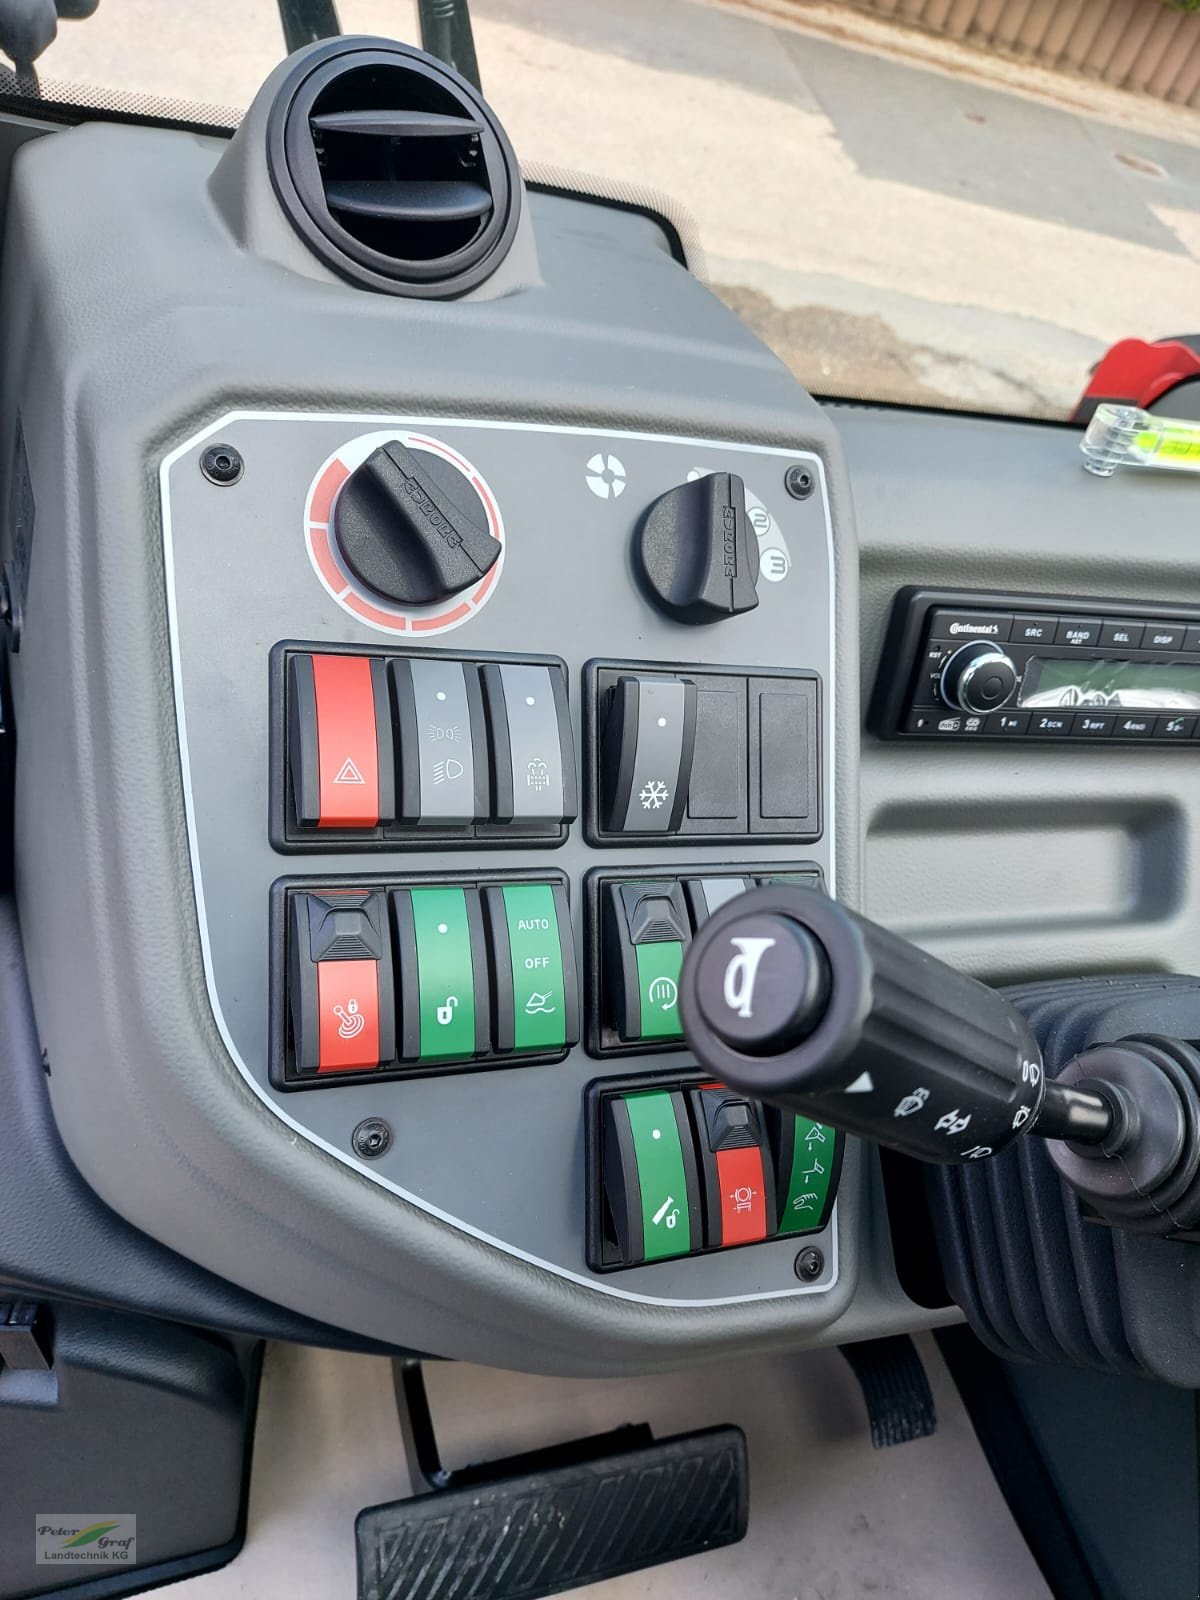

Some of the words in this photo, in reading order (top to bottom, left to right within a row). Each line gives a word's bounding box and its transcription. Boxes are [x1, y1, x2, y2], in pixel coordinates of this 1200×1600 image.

[754, 513, 767, 528] 2
[770, 556, 786, 574] 3
[949, 622, 992, 635] Continental
[1024, 627, 1043, 638] SRC
[1066, 630, 1090, 640] BAND
[1113, 633, 1129, 642] SEL
[1153, 635, 1173, 644] DISP
[518, 919, 549, 930] AUTO
[525, 957, 550, 969] OFF
